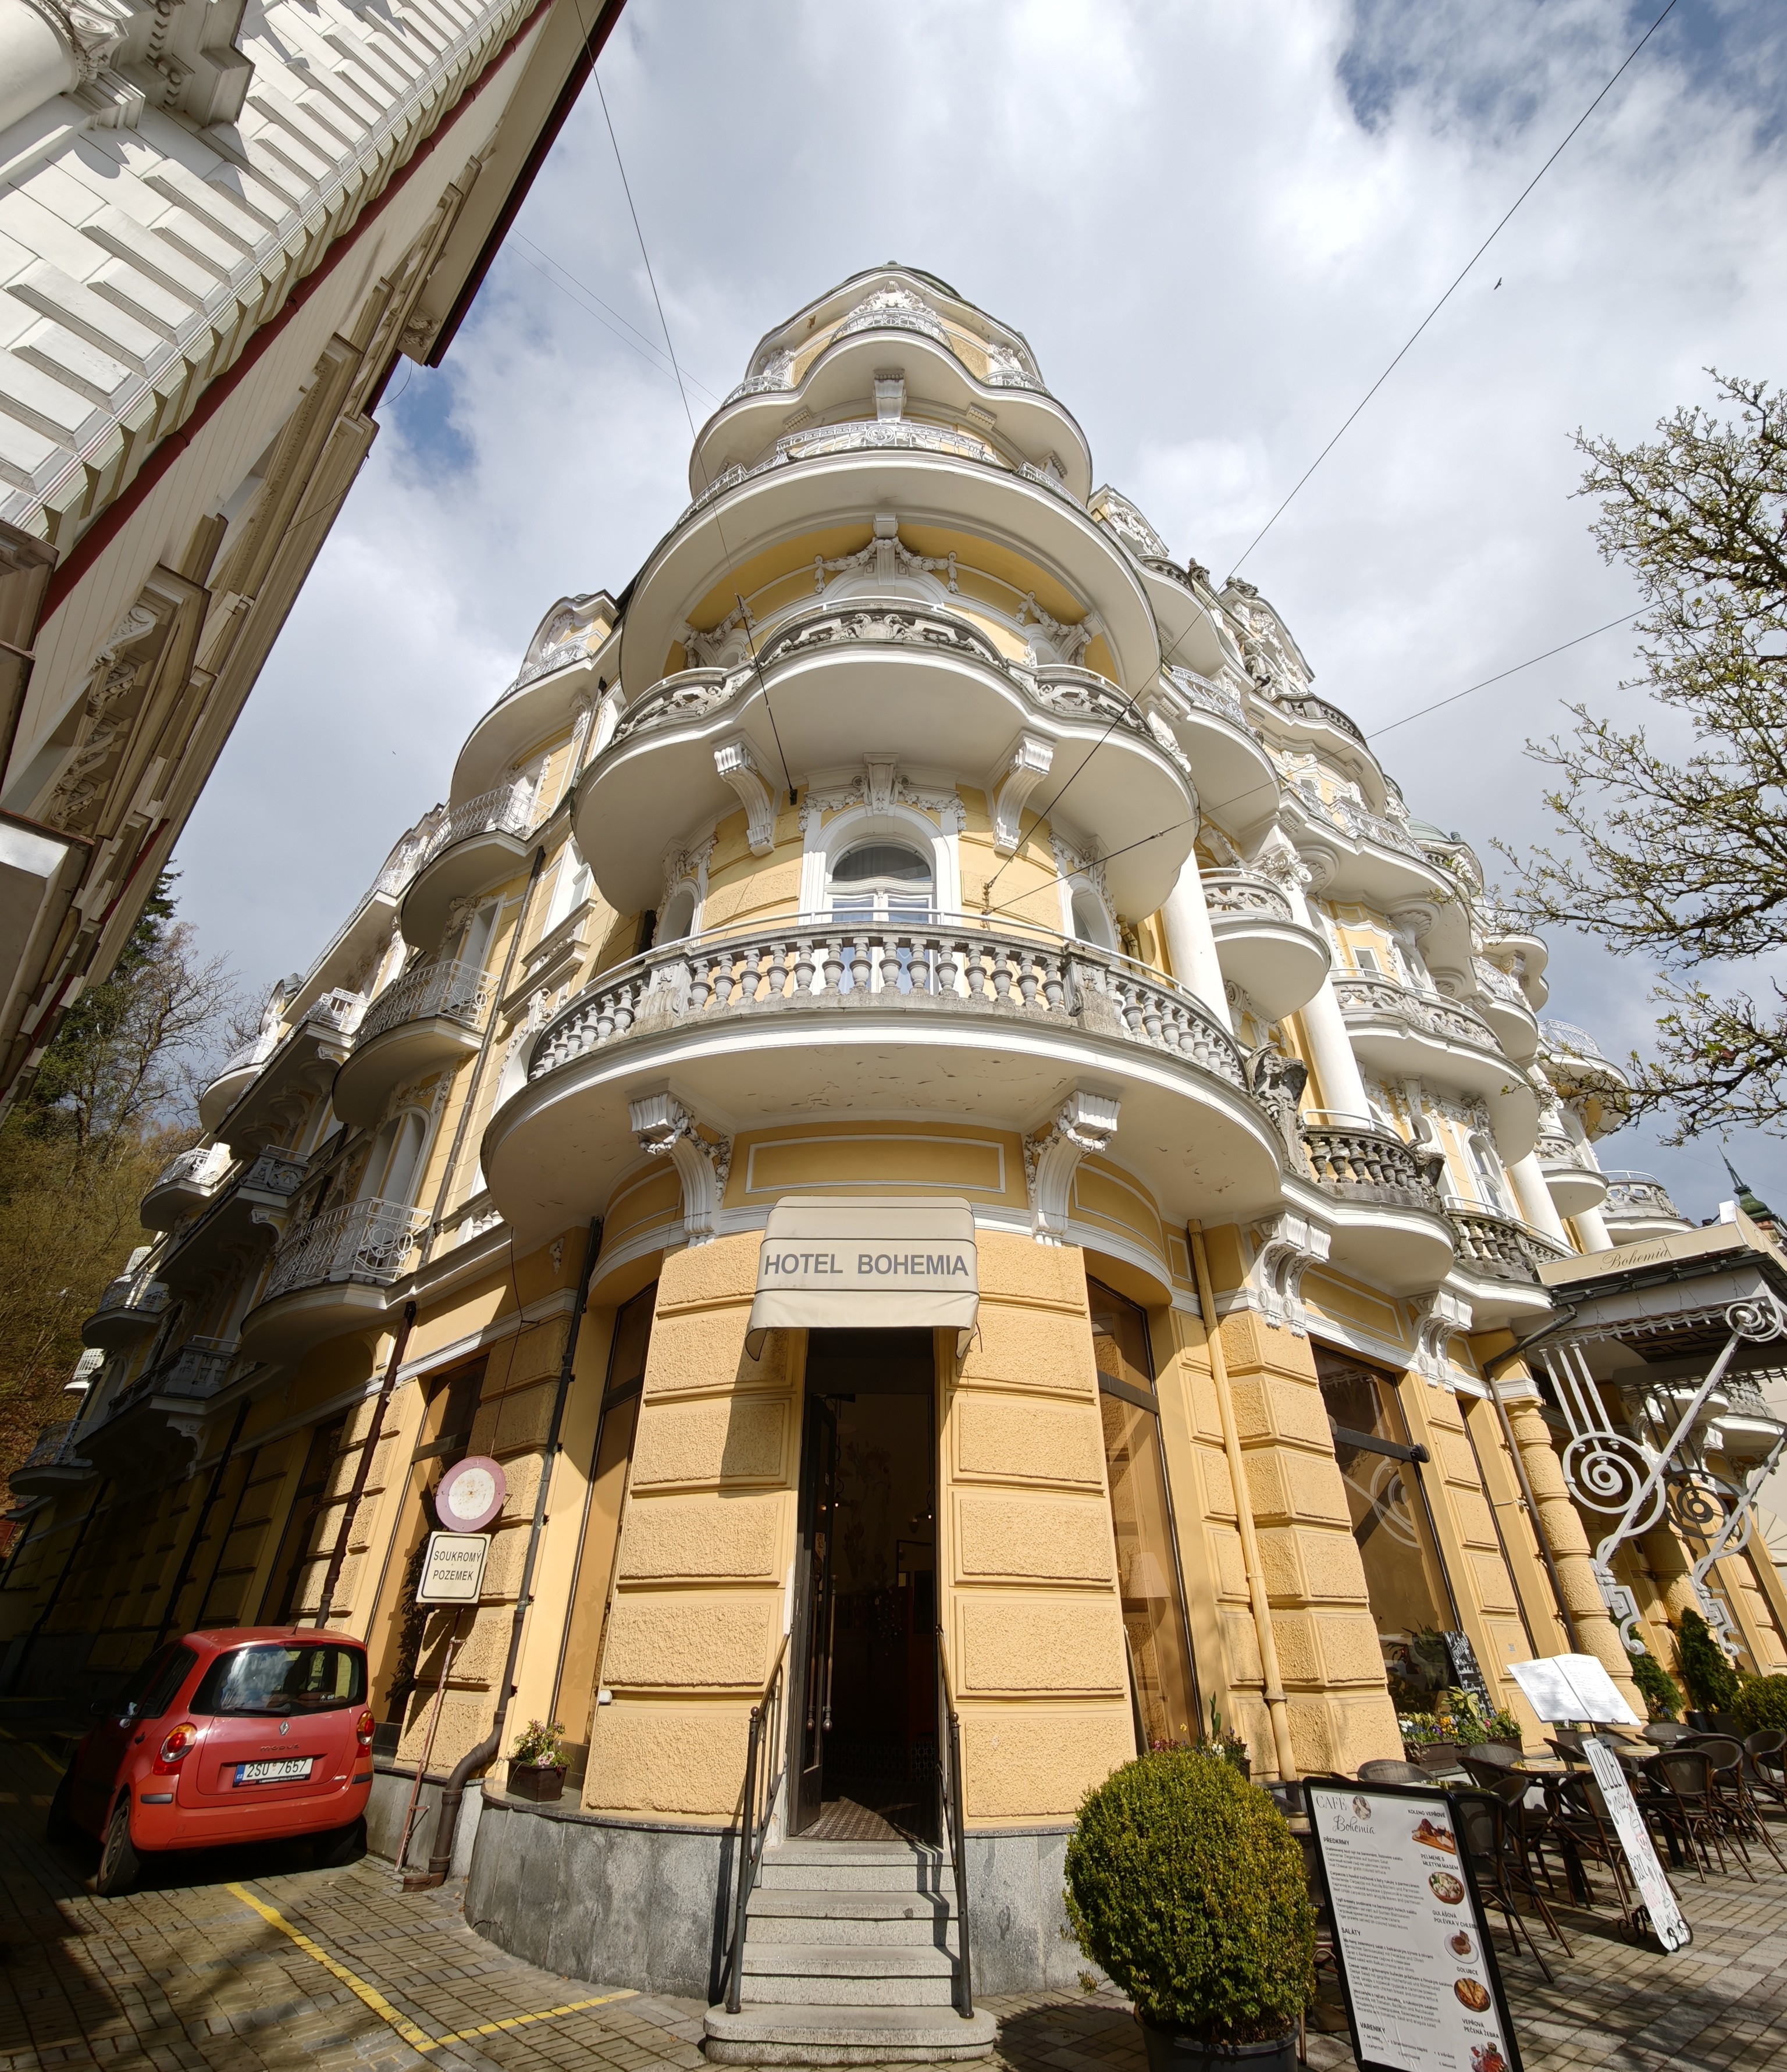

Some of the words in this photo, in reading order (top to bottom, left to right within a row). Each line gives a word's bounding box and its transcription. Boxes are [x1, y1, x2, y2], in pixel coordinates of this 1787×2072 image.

[764, 1253, 843, 1275] HOTEL
[858, 1254, 969, 1276] BOHEMIA
[1600, 1247, 1669, 1271] Bohemia
[433, 1550, 482, 1563] SOUKROMÝ
[432, 1570, 474, 1581] POZEMEK
[246, 1763, 269, 1778] 2SU
[277, 1759, 307, 1775] 7657
[1316, 1793, 1347, 1811] CAFÉ
[1332, 1814, 1376, 1835] Bohemia
[1323, 1836, 1350, 1846] PŘEDKRMY
[1421, 1853, 1441, 1862] PELMENE
[1434, 1917, 1455, 1925] POLÉVKA
[1341, 1927, 1361, 1936] SALÁTY
[1457, 1966, 1479, 1976] GOLUBCE
[1359, 2021, 1385, 2034] VARENIKY
[1464, 2026, 1483, 2035] PEČENÁ
